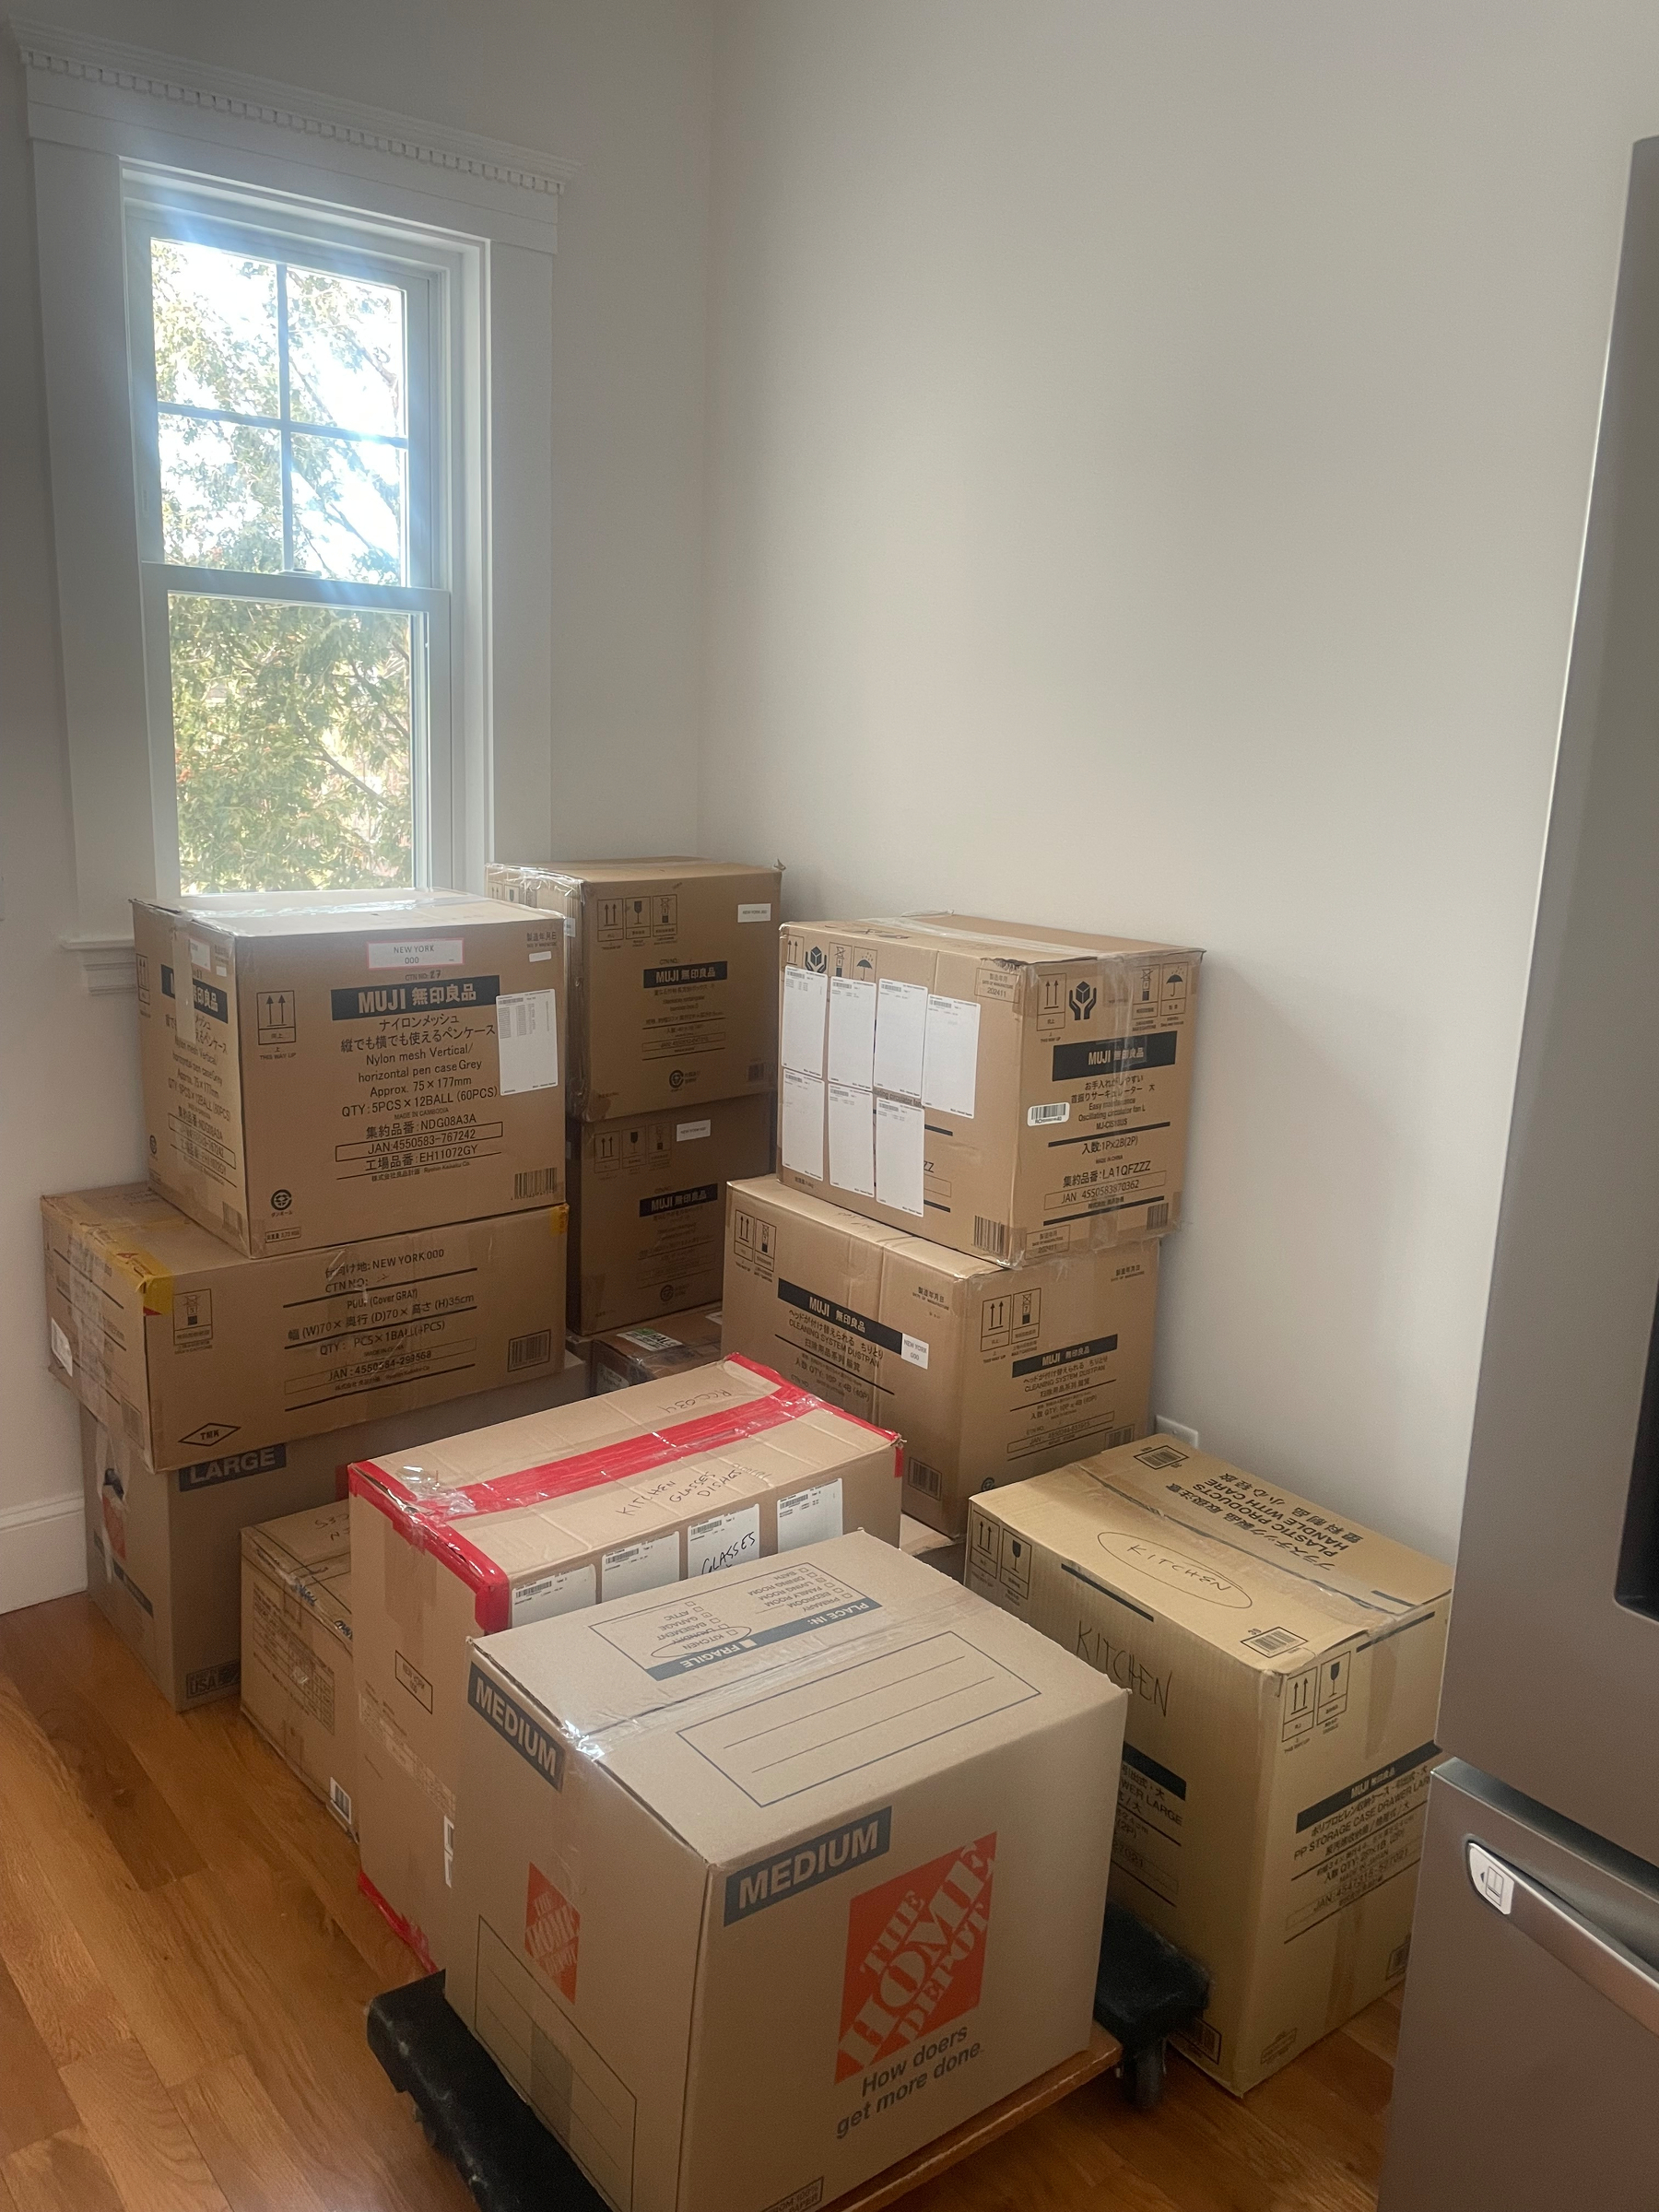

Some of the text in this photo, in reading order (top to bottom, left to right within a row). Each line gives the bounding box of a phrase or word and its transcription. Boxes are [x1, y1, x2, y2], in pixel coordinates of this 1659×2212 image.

[393, 944, 435, 954] NEW YORK
[656, 967, 716, 984] MUJI 無印良品
[358, 982, 477, 1014] MUJI 無印良品
[986, 986, 1006, 997] 202411
[379, 1014, 459, 1031] ナイロンメッシュ
[340, 1024, 496, 1053] 縦でも横でも使えるペンケース
[366, 1041, 474, 1065] Nylon mesh Vertical/
[1088, 1047, 1145, 1065] MUJI 無印良品
[358, 1067, 409, 1083] horizontal
[413, 1067, 431, 1078] pen
[371, 1086, 409, 1098] Approx.
[456, 1086, 498, 1103] (60PCS)
[1071, 1087, 1143, 1104] 首振りサーキュレーター
[394, 1112, 411, 1120] MADE
[418, 1107, 449, 1116] CAMBODIA
[1078, 1112, 1107, 1123] Oscillating
[1088, 1102, 1102, 1111] Easy
[651, 1189, 707, 1212] MUJI 無印良品
[1062, 1193, 1077, 1204] JAN
[372, 1257, 396, 1270] NEW
[398, 1252, 425, 1265] YORK
[426, 1248, 444, 1260] 000
[324, 1281, 347, 1294] CTN
[371, 1293, 394, 1307] (Cover
[288, 1294, 474, 1340] 幅 奥行 高さ (H)35cm
[809, 1296, 866, 1333] MUJI 無印良品
[788, 1309, 884, 1360] ヘッドが付け替えられる ちりとり
[789, 1318, 879, 1369] CLEANING SYSTEM DUSTPAN
[903, 1338, 927, 1354] NEW YORK
[1041, 1346, 1090, 1366] MUJI 無印良品
[809, 1362, 824, 1378] QTY:
[843, 1382, 852, 1392] 4B
[853, 1388, 870, 1403] (40P)
[1025, 1365, 1106, 1394] CLEANING SYSTEM DUSTPAN
[199, 1429, 220, 1440] TMK
[188, 1447, 276, 1485] LARGE
[669, 1471, 717, 1503] GLASSES
[697, 1469, 743, 1497] DISHES
[616, 1480, 677, 1516] KITCHEN
[1192, 1483, 1338, 1558] PLASTIC PRODUCTS
[1204, 1478, 1349, 1551] HANDLE WITH CARE
[1166, 1482, 1336, 1571] プラスチック製品 取扱注意
[701, 1532, 756, 1575] GLASSES
[772, 1570, 796, 1580] BATH
[1126, 1545, 1231, 1591] KITCHEN
[747, 1575, 806, 1596] DINING ROOM
[758, 1580, 815, 1602] LIVING ROOM
[763, 1585, 822, 1607] FAMILY ROOM
[787, 1592, 831, 1609] BEDROOM
[802, 1596, 841, 1613] PRIMARY
[660, 1617, 699, 1631] GARAGE
[664, 1609, 689, 1622] ATTIC
[806, 1600, 870, 1627] PLACE IN:
[656, 1620, 708, 1641] BASEMENT
[682, 1633, 724, 1650] KITCHEN
[680, 1642, 741, 1669] FRAGILE
[1076, 1620, 1172, 1717] KITCHEN
[474, 1678, 557, 1777] MEDIUM
[1351, 1779, 1370, 1799] MUJI
[1121, 1779, 1183, 1826] WER LARGE
[1294, 1788, 1412, 1860] PP STORAGE CASE DRAWER
[737, 1818, 880, 1911] MEDIUM
[859, 1889, 925, 1975] THE
[838, 1841, 997, 2067] HOME
[898, 1900, 989, 2044] DEPOT
[862, 2026, 968, 2098] How doers
[837, 2102, 872, 2140] get
[876, 2074, 928, 2114] more
